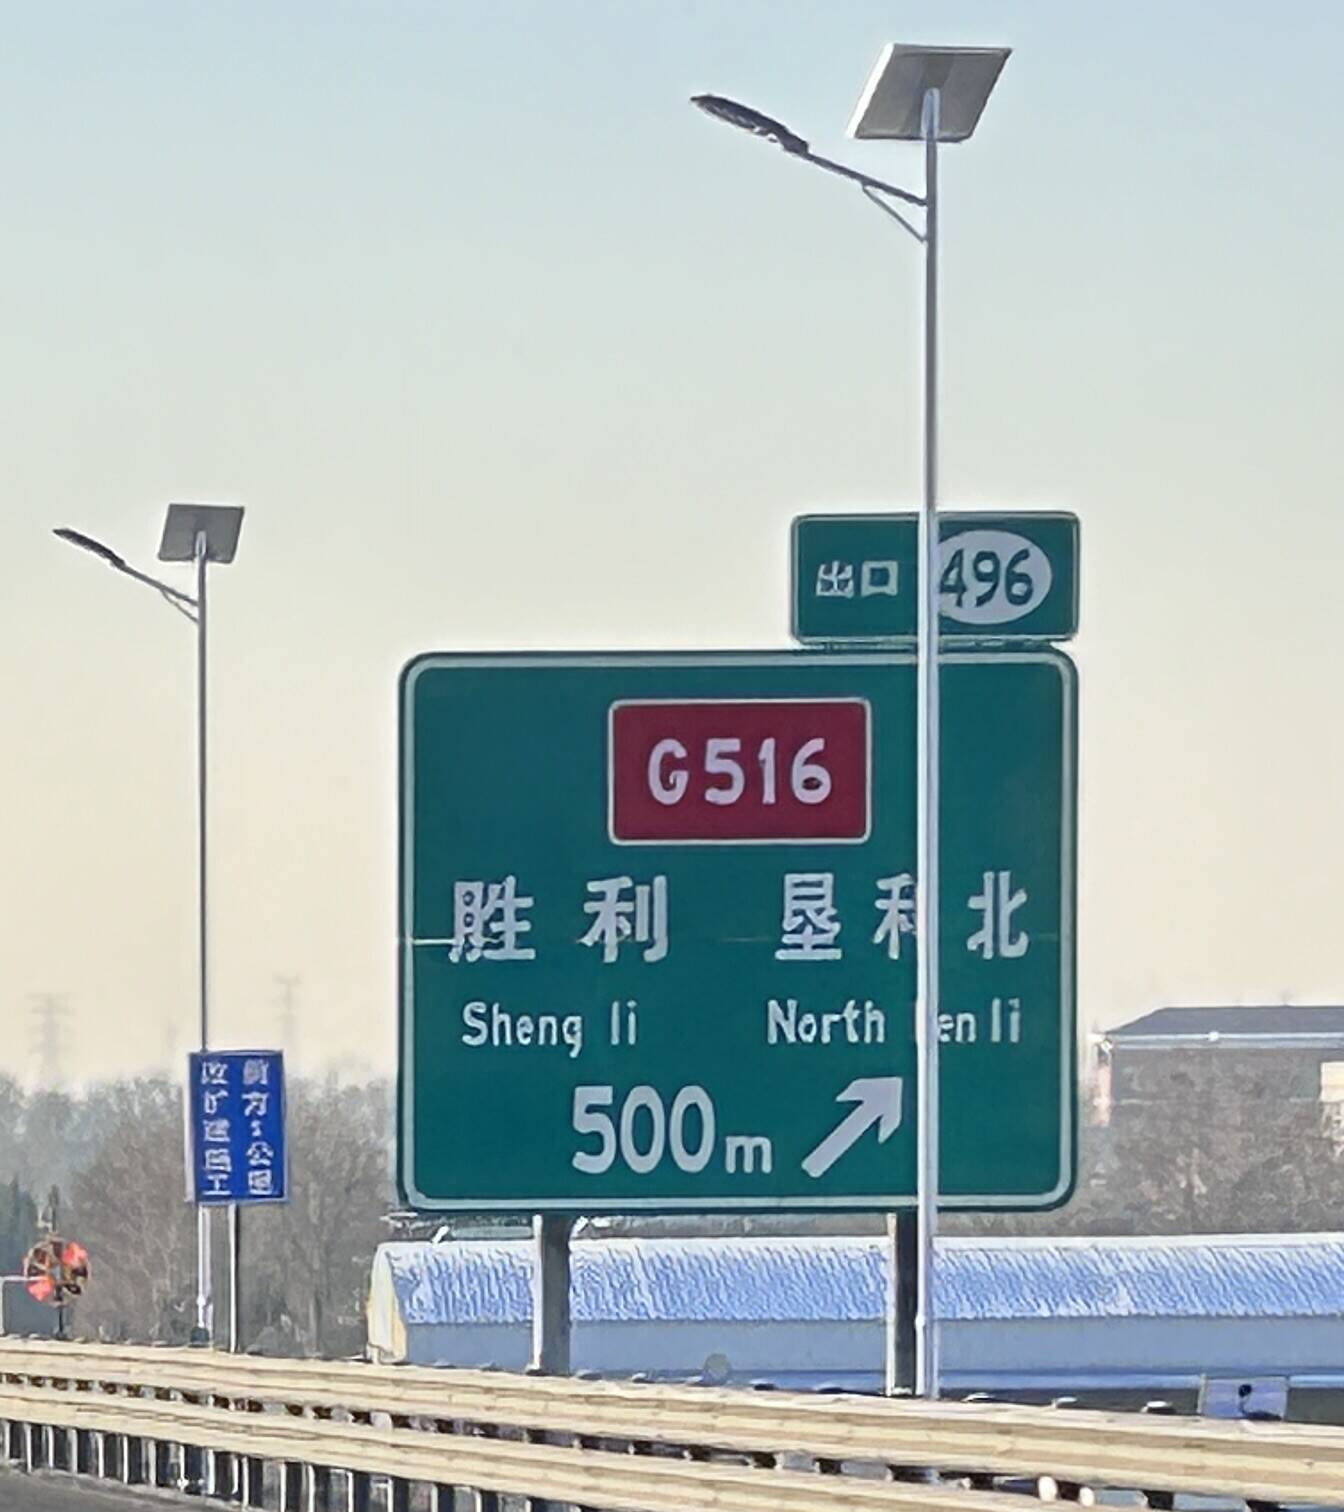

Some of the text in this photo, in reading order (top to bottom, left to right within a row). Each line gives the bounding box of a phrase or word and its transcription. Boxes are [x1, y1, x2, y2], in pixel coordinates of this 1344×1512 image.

[816, 549, 1034, 608] 出口 496
[647, 737, 832, 806] G516
[448, 875, 669, 963] 胜利
[462, 1001, 583, 1058] Sheng
[767, 999, 886, 1044] North
[916, 1002, 977, 1044] en
[572, 1084, 773, 1175] 500m
